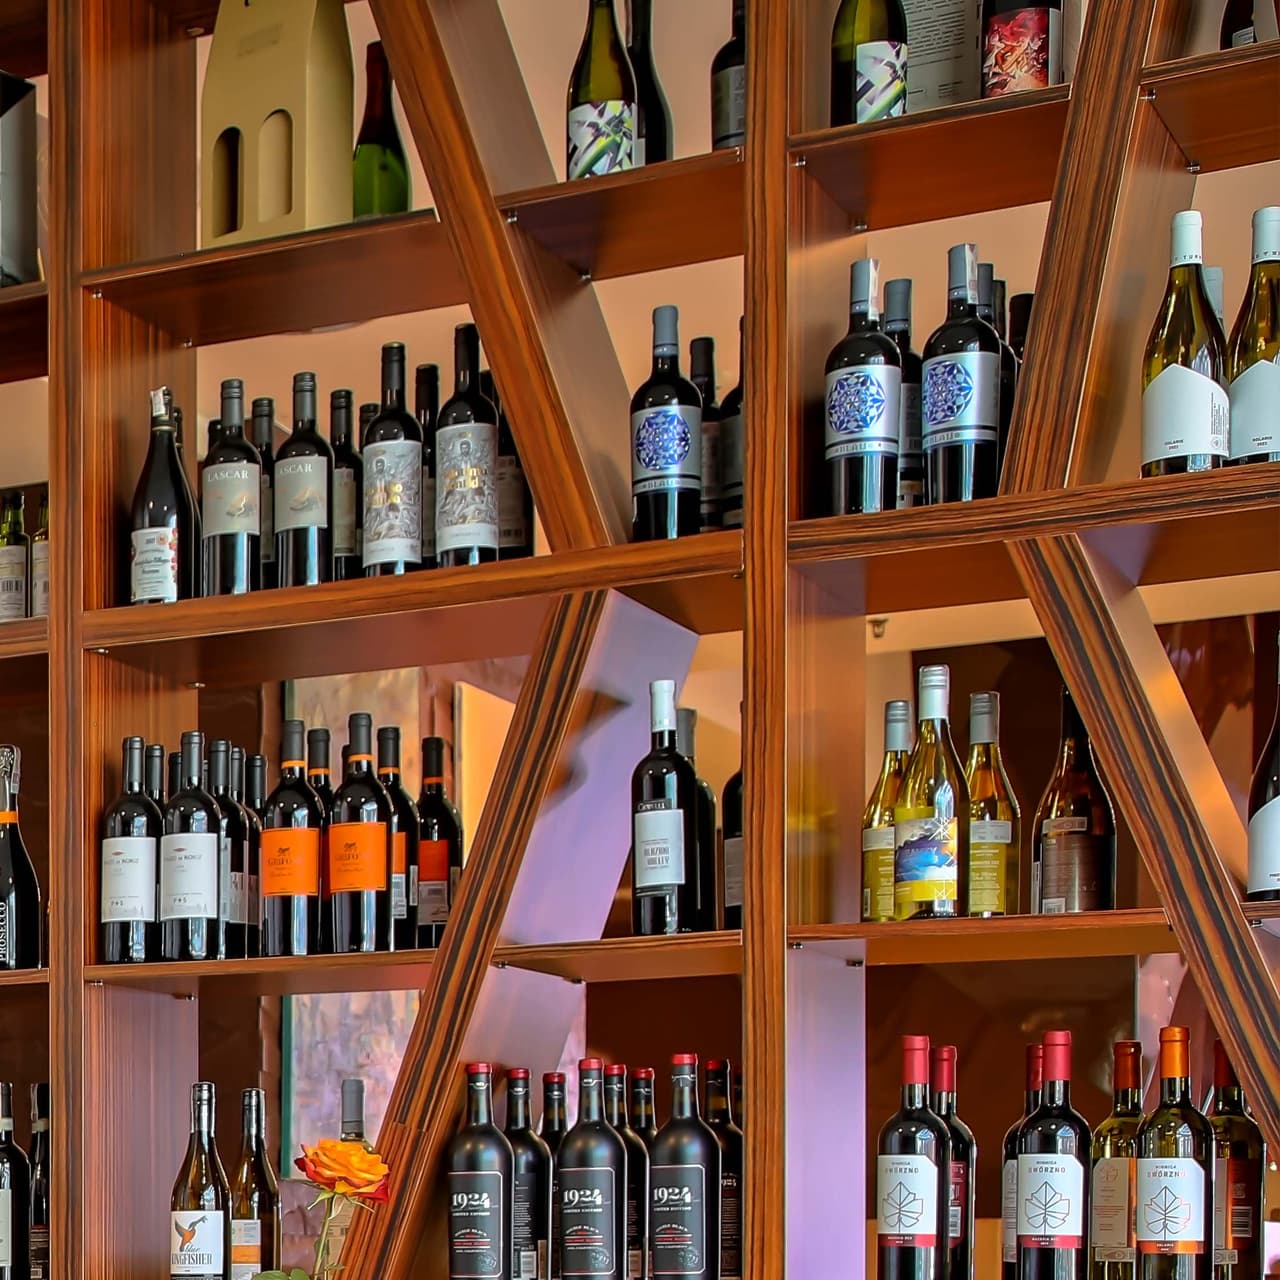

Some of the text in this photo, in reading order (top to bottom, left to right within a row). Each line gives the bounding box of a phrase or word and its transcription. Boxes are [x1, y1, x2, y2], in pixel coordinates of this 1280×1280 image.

[208, 470, 249, 482] LASCAR
[452, 1192, 491, 1209] 1924
[563, 1188, 602, 1208] 1924
[653, 1186, 692, 1204] 1924
